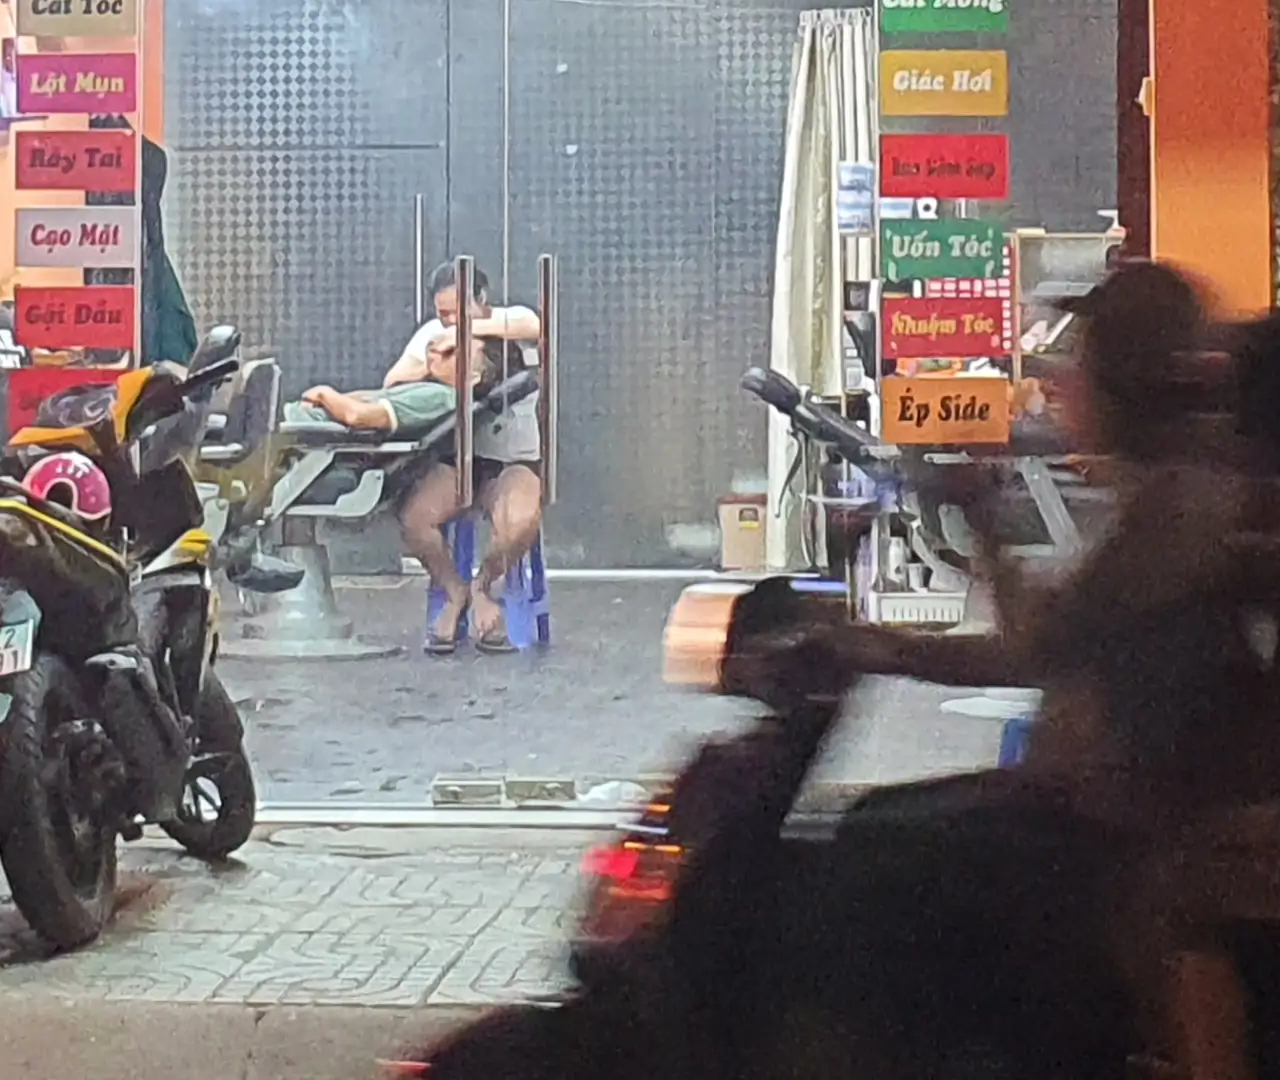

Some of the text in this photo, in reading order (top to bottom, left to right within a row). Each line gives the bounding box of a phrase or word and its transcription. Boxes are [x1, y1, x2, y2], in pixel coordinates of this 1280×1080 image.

[73, 71, 125, 99] Mụn
[892, 67, 946, 92] Giác
[30, 222, 72, 254] Cạo
[891, 229, 993, 258] Uốn Tóc
[960, 311, 995, 334] Tóc
[898, 386, 990, 428] Ép Side
